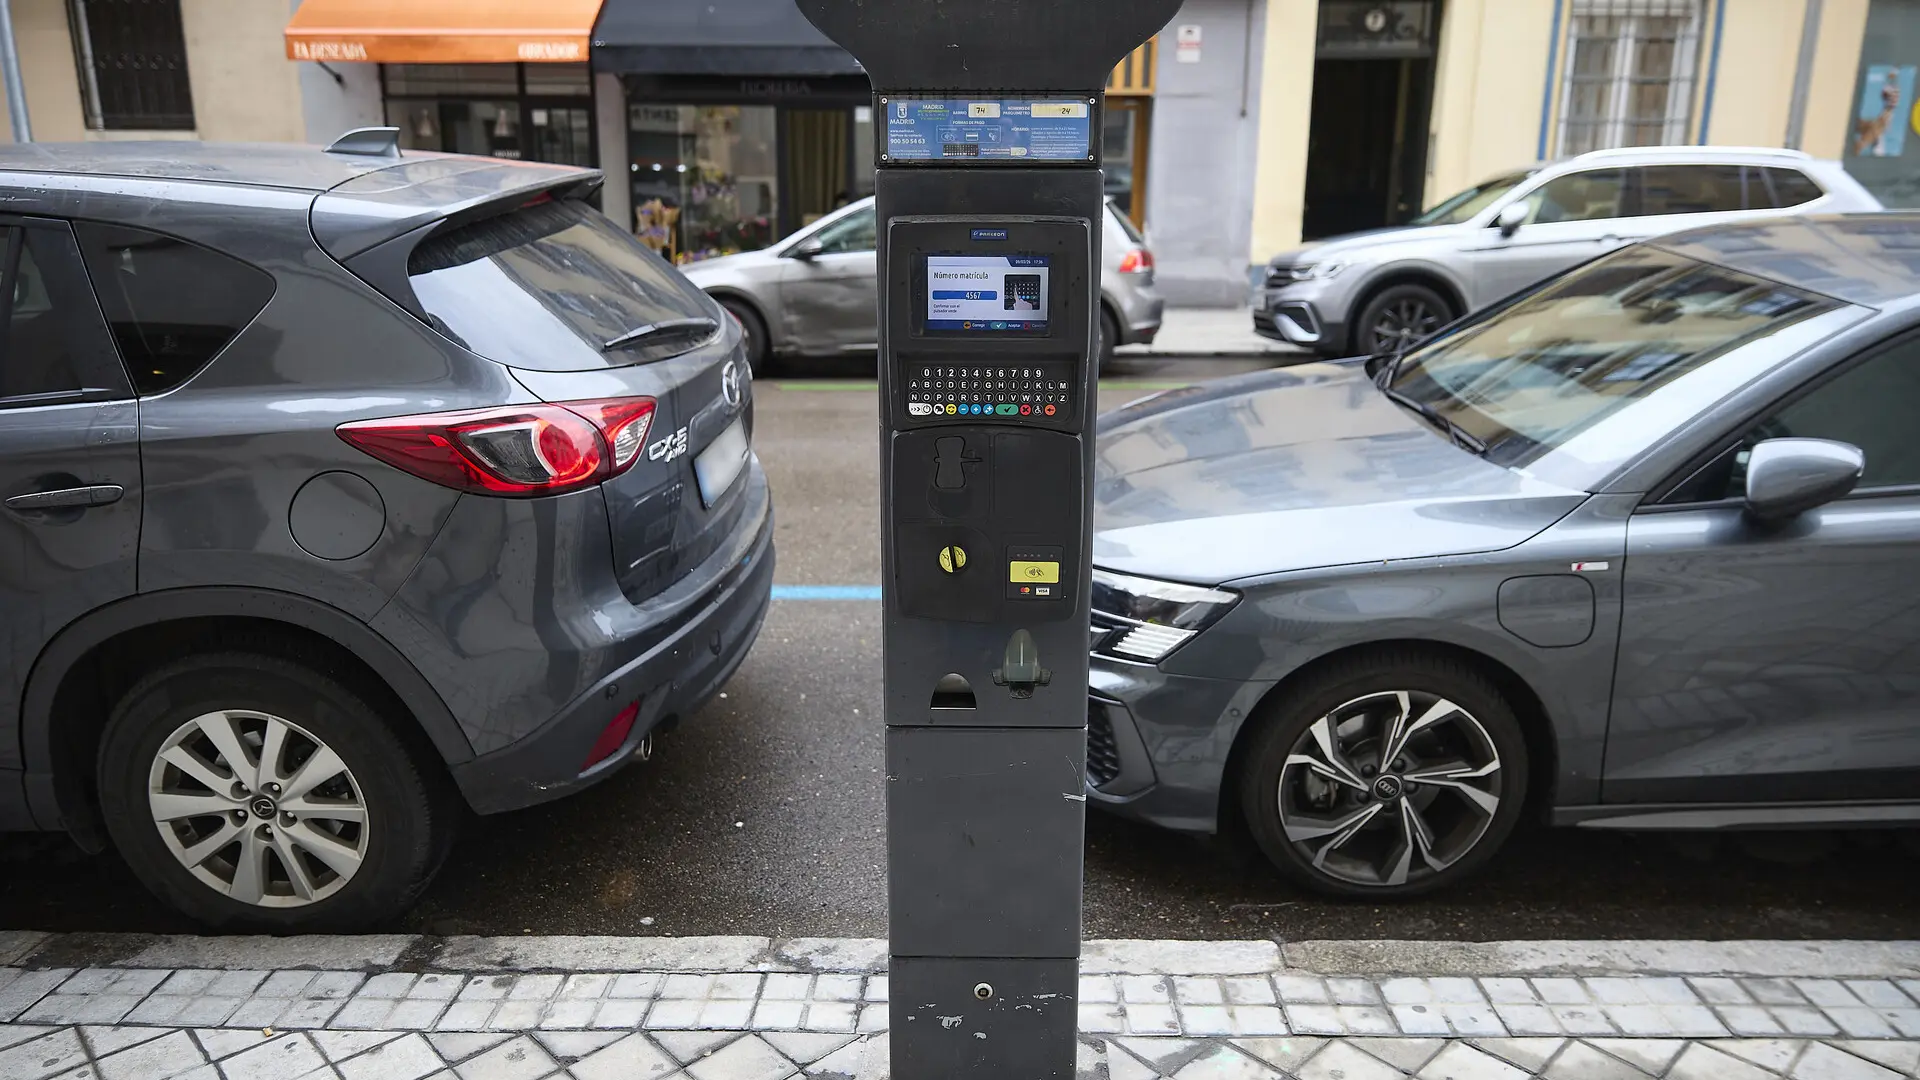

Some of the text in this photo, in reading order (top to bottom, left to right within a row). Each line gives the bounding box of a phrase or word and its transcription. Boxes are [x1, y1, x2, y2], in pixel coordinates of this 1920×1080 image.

[924, 368, 1042, 378] 0 1 2 3 4 5 6 7 8 9
[961, 381, 967, 389] E
[648, 426, 687, 461] CX-5
